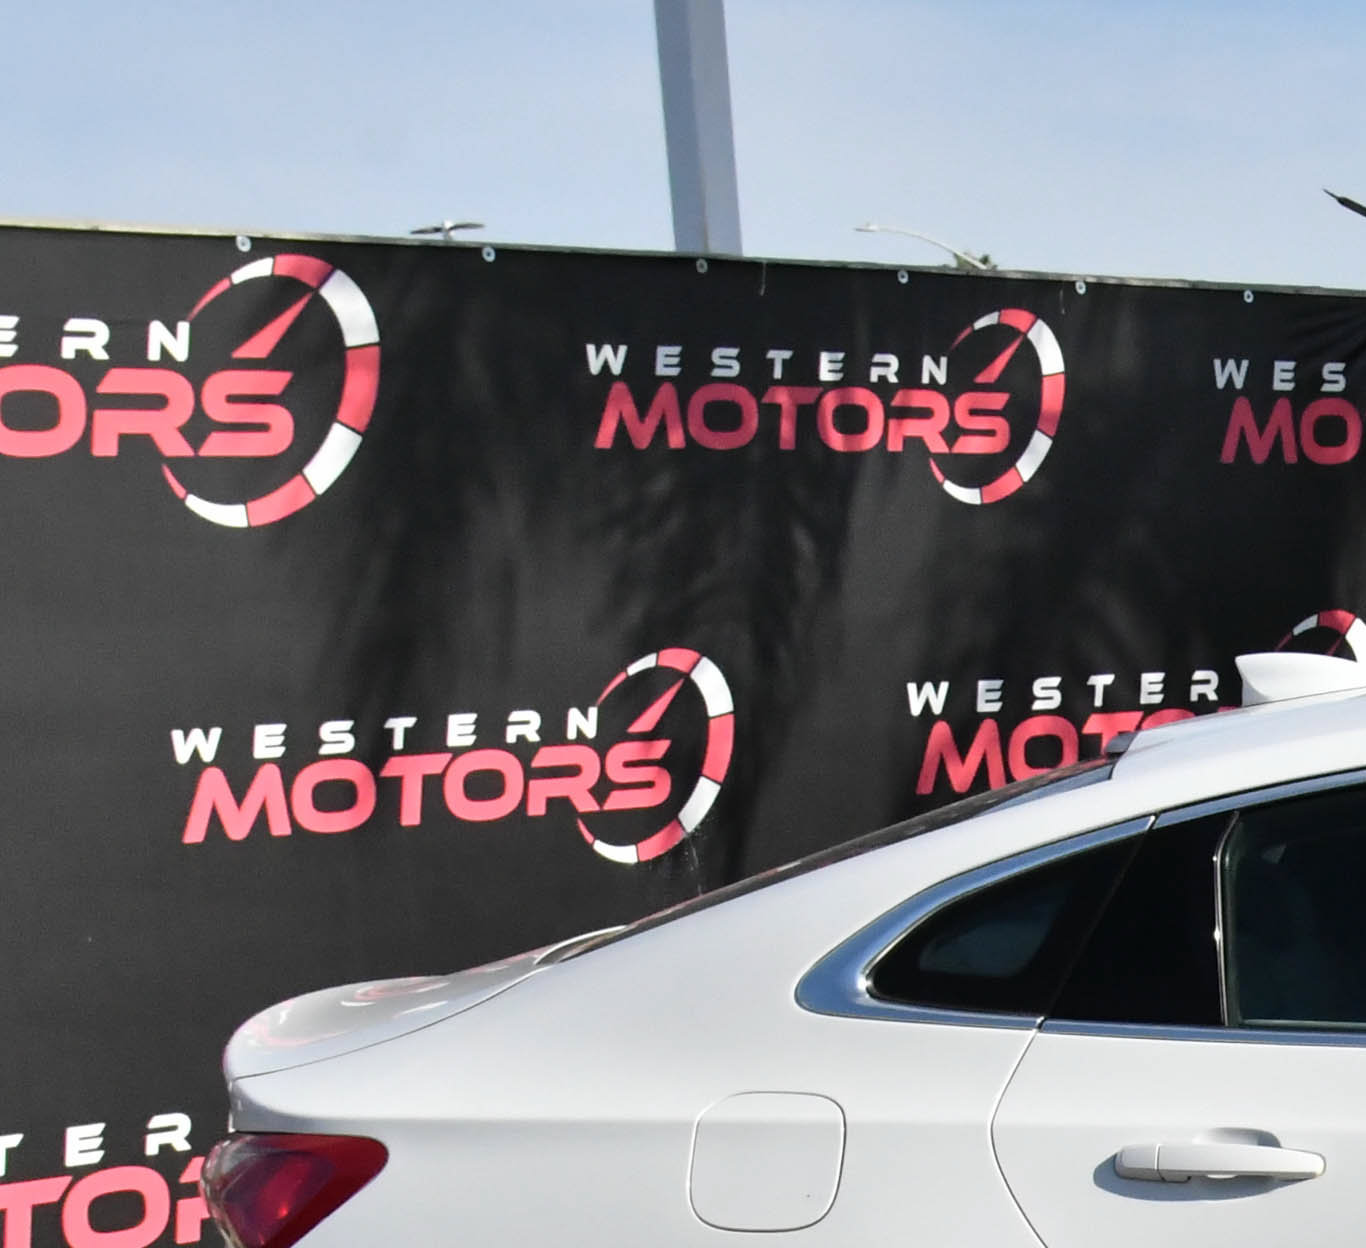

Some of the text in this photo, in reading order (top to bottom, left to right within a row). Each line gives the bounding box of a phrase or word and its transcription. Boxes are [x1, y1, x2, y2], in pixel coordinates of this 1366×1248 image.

[585, 343, 949, 386] WESTERN
[594, 380, 1011, 455] MOTORS
[906, 669, 1219, 717] WESTER
[170, 706, 599, 765] WESTERN
[181, 739, 672, 844] MOTORS
